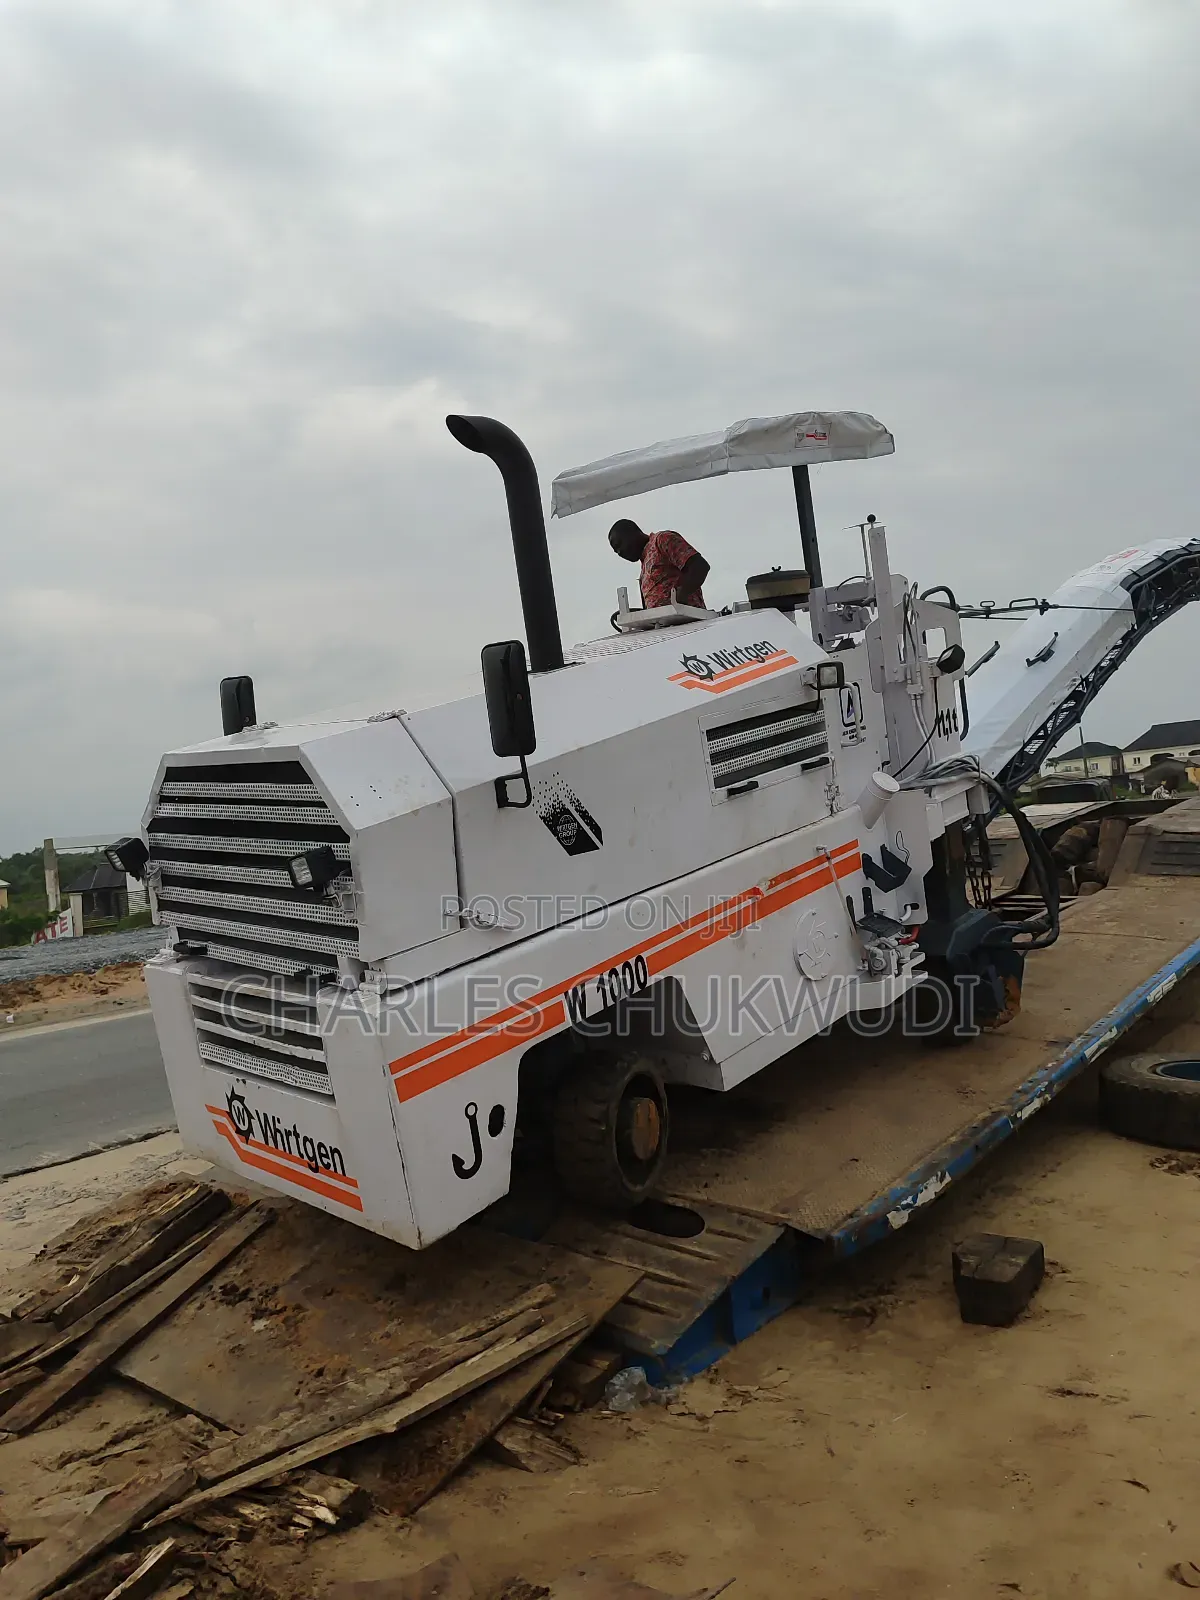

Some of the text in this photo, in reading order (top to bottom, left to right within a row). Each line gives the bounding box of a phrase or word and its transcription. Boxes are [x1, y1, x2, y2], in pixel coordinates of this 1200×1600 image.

[706, 640, 779, 671] Wirtgen
[563, 954, 647, 1024] W 1000
[254, 1109, 347, 1177] Wirtgen
